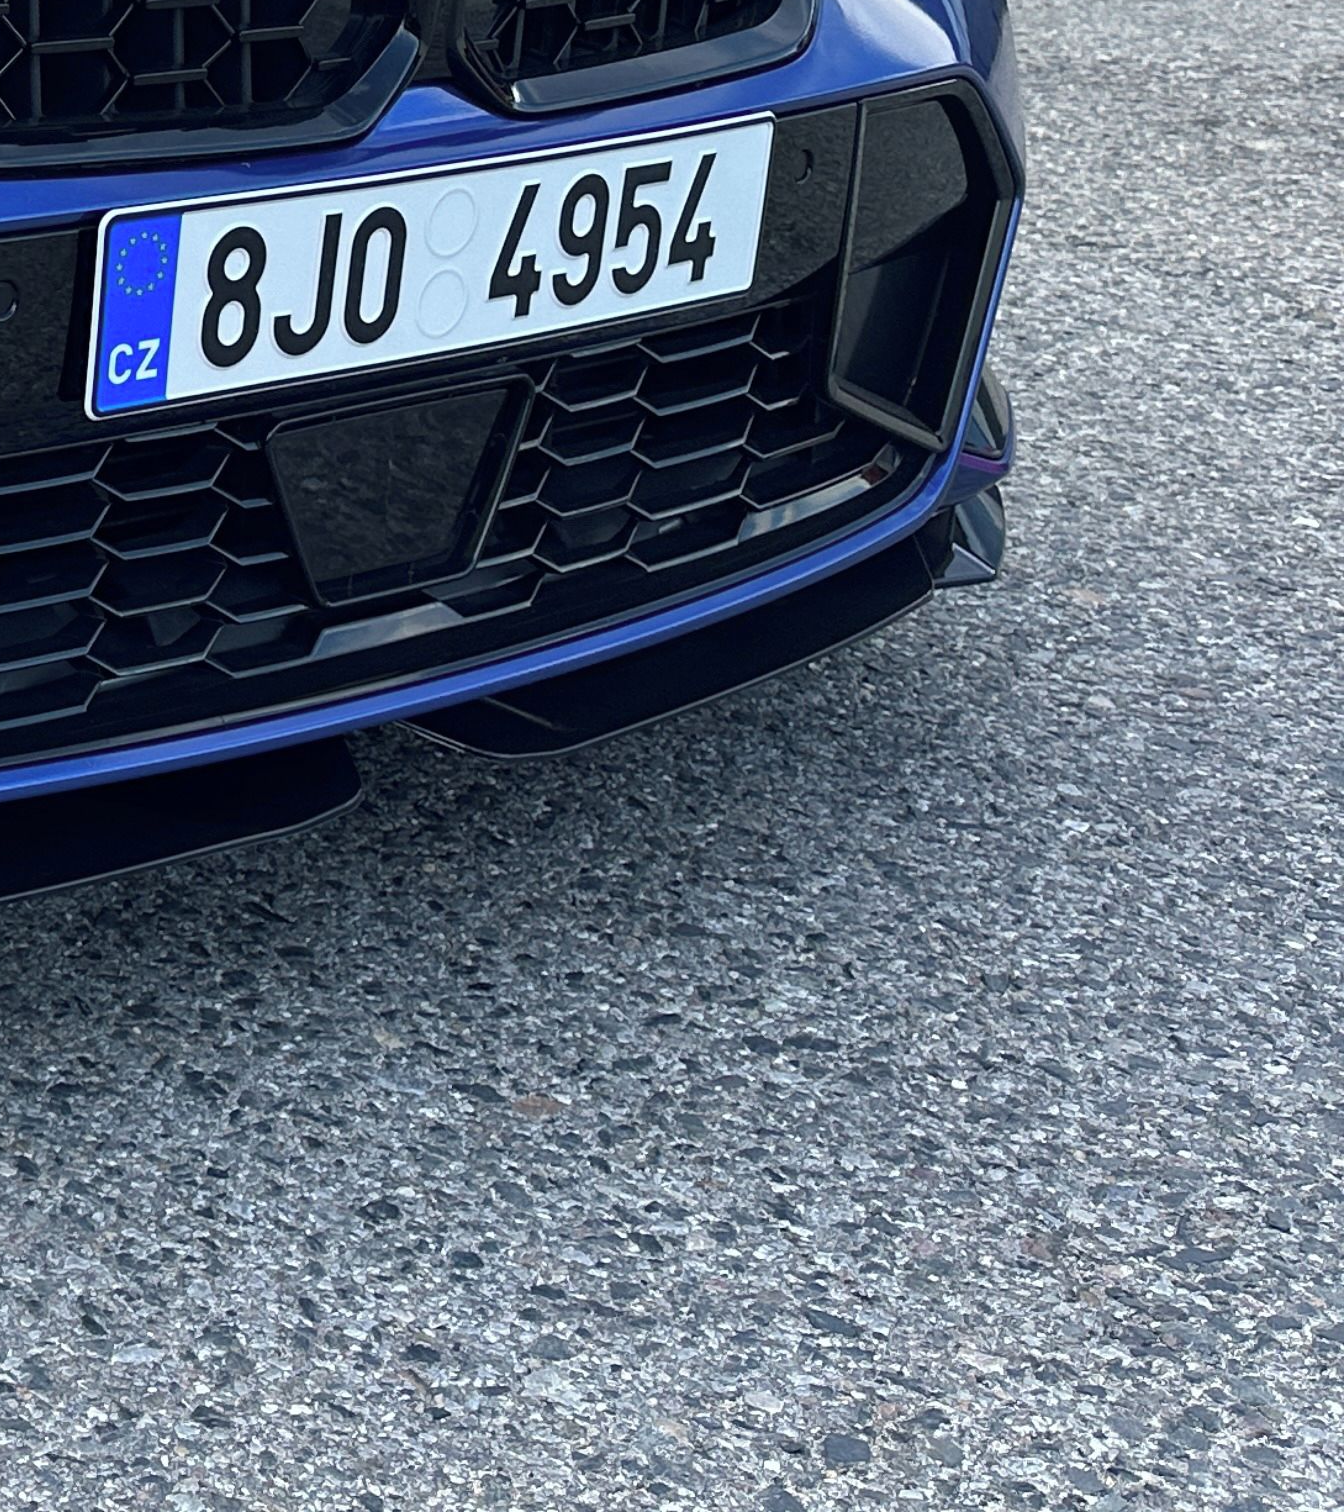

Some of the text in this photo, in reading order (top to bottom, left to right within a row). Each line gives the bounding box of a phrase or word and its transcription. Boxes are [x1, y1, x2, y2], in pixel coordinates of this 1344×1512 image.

[200, 152, 717, 368] 8J0 4954
[107, 337, 161, 386] CZ
